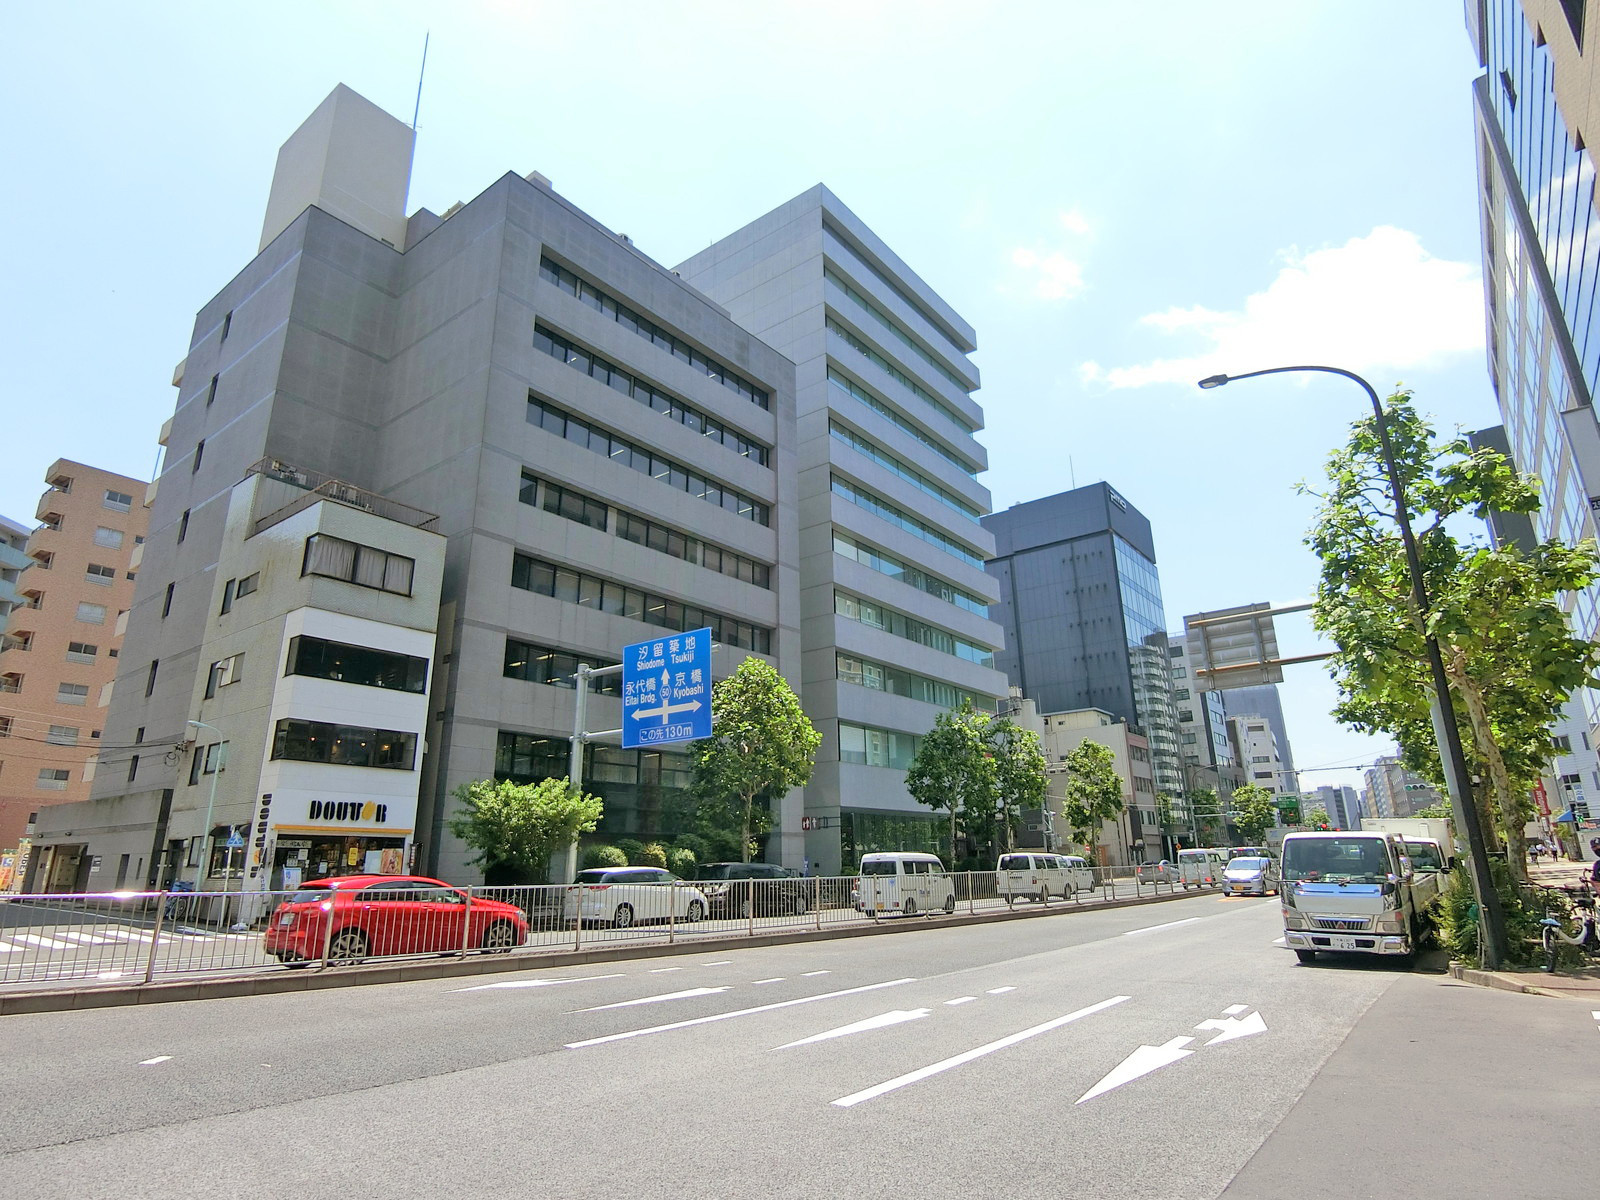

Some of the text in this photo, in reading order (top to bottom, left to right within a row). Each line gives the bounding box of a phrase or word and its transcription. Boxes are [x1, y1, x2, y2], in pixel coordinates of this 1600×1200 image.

[638, 635, 696, 660] 汐留 築地
[636, 650, 695, 671] Shiodome Tsukiji
[625, 677, 656, 696] 永代橋
[675, 669, 702, 686] 京橋
[625, 692, 657, 706] Eitai Brdg.
[674, 685, 703, 699] Kyobashi
[309, 800, 388, 822] DOUTOR
